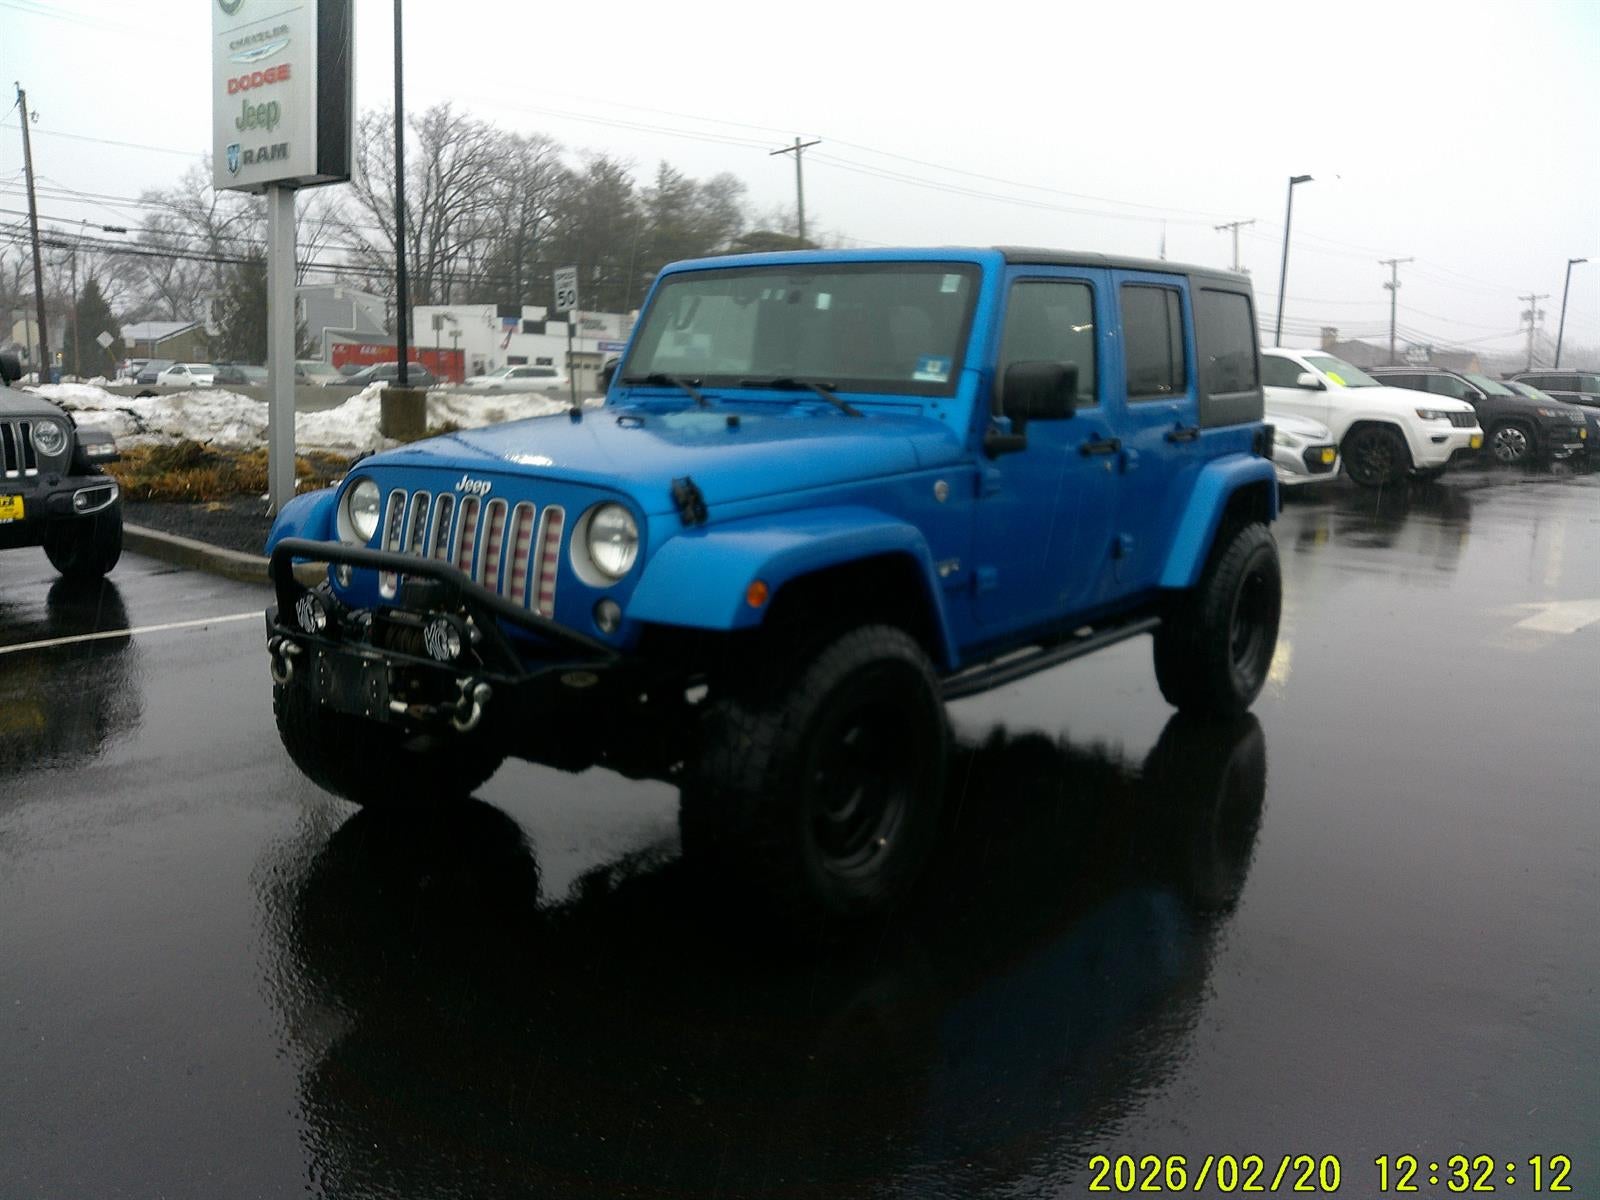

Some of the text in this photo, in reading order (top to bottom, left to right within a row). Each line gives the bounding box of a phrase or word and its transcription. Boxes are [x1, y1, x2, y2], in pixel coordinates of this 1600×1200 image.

[227, 63, 291, 95] DODGE
[235, 99, 281, 133] Jeep
[243, 143, 289, 165] RAM
[558, 290, 576, 306] 50
[455, 473, 492, 498] Jeep
[296, 597, 316, 633] KC
[424, 620, 450, 660] KC
